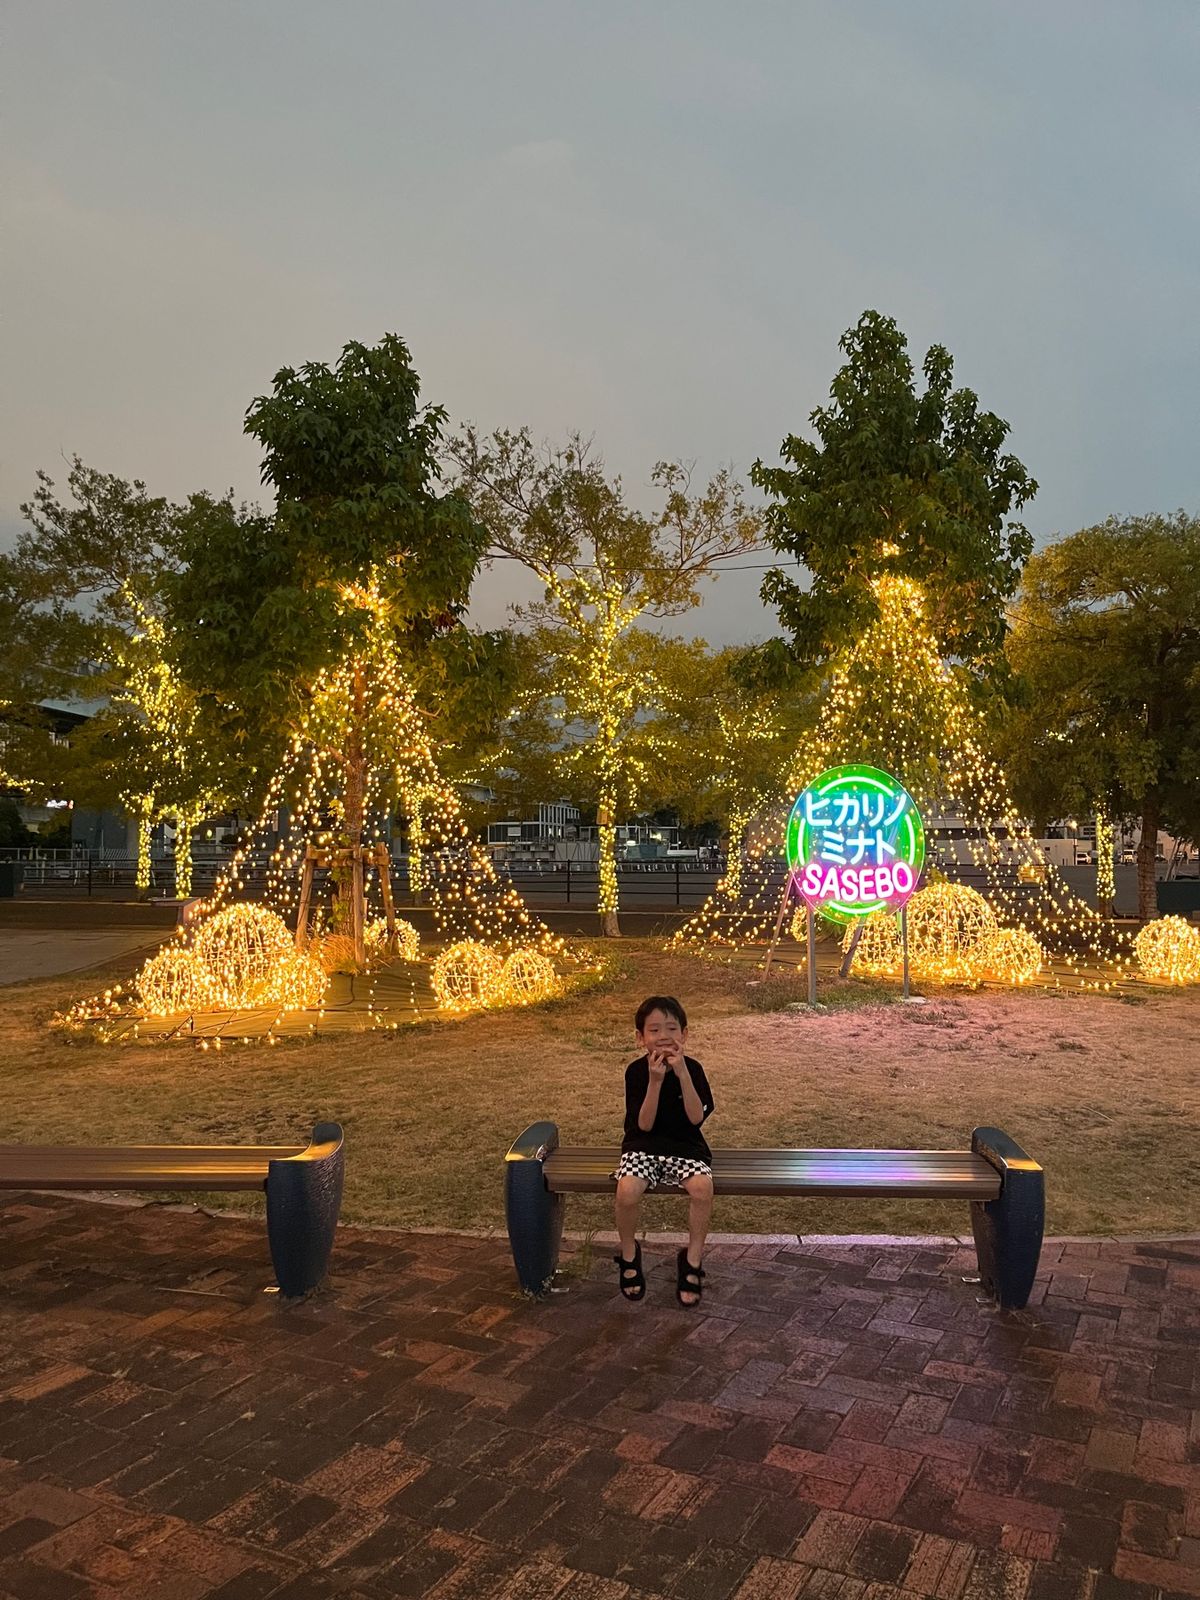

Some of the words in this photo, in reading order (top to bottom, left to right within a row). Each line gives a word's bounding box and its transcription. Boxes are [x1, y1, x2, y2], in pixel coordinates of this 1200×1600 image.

[806, 792, 907, 827] ヒカリノ
[821, 829, 896, 865] ミナト
[802, 862, 913, 901] SASEBO
